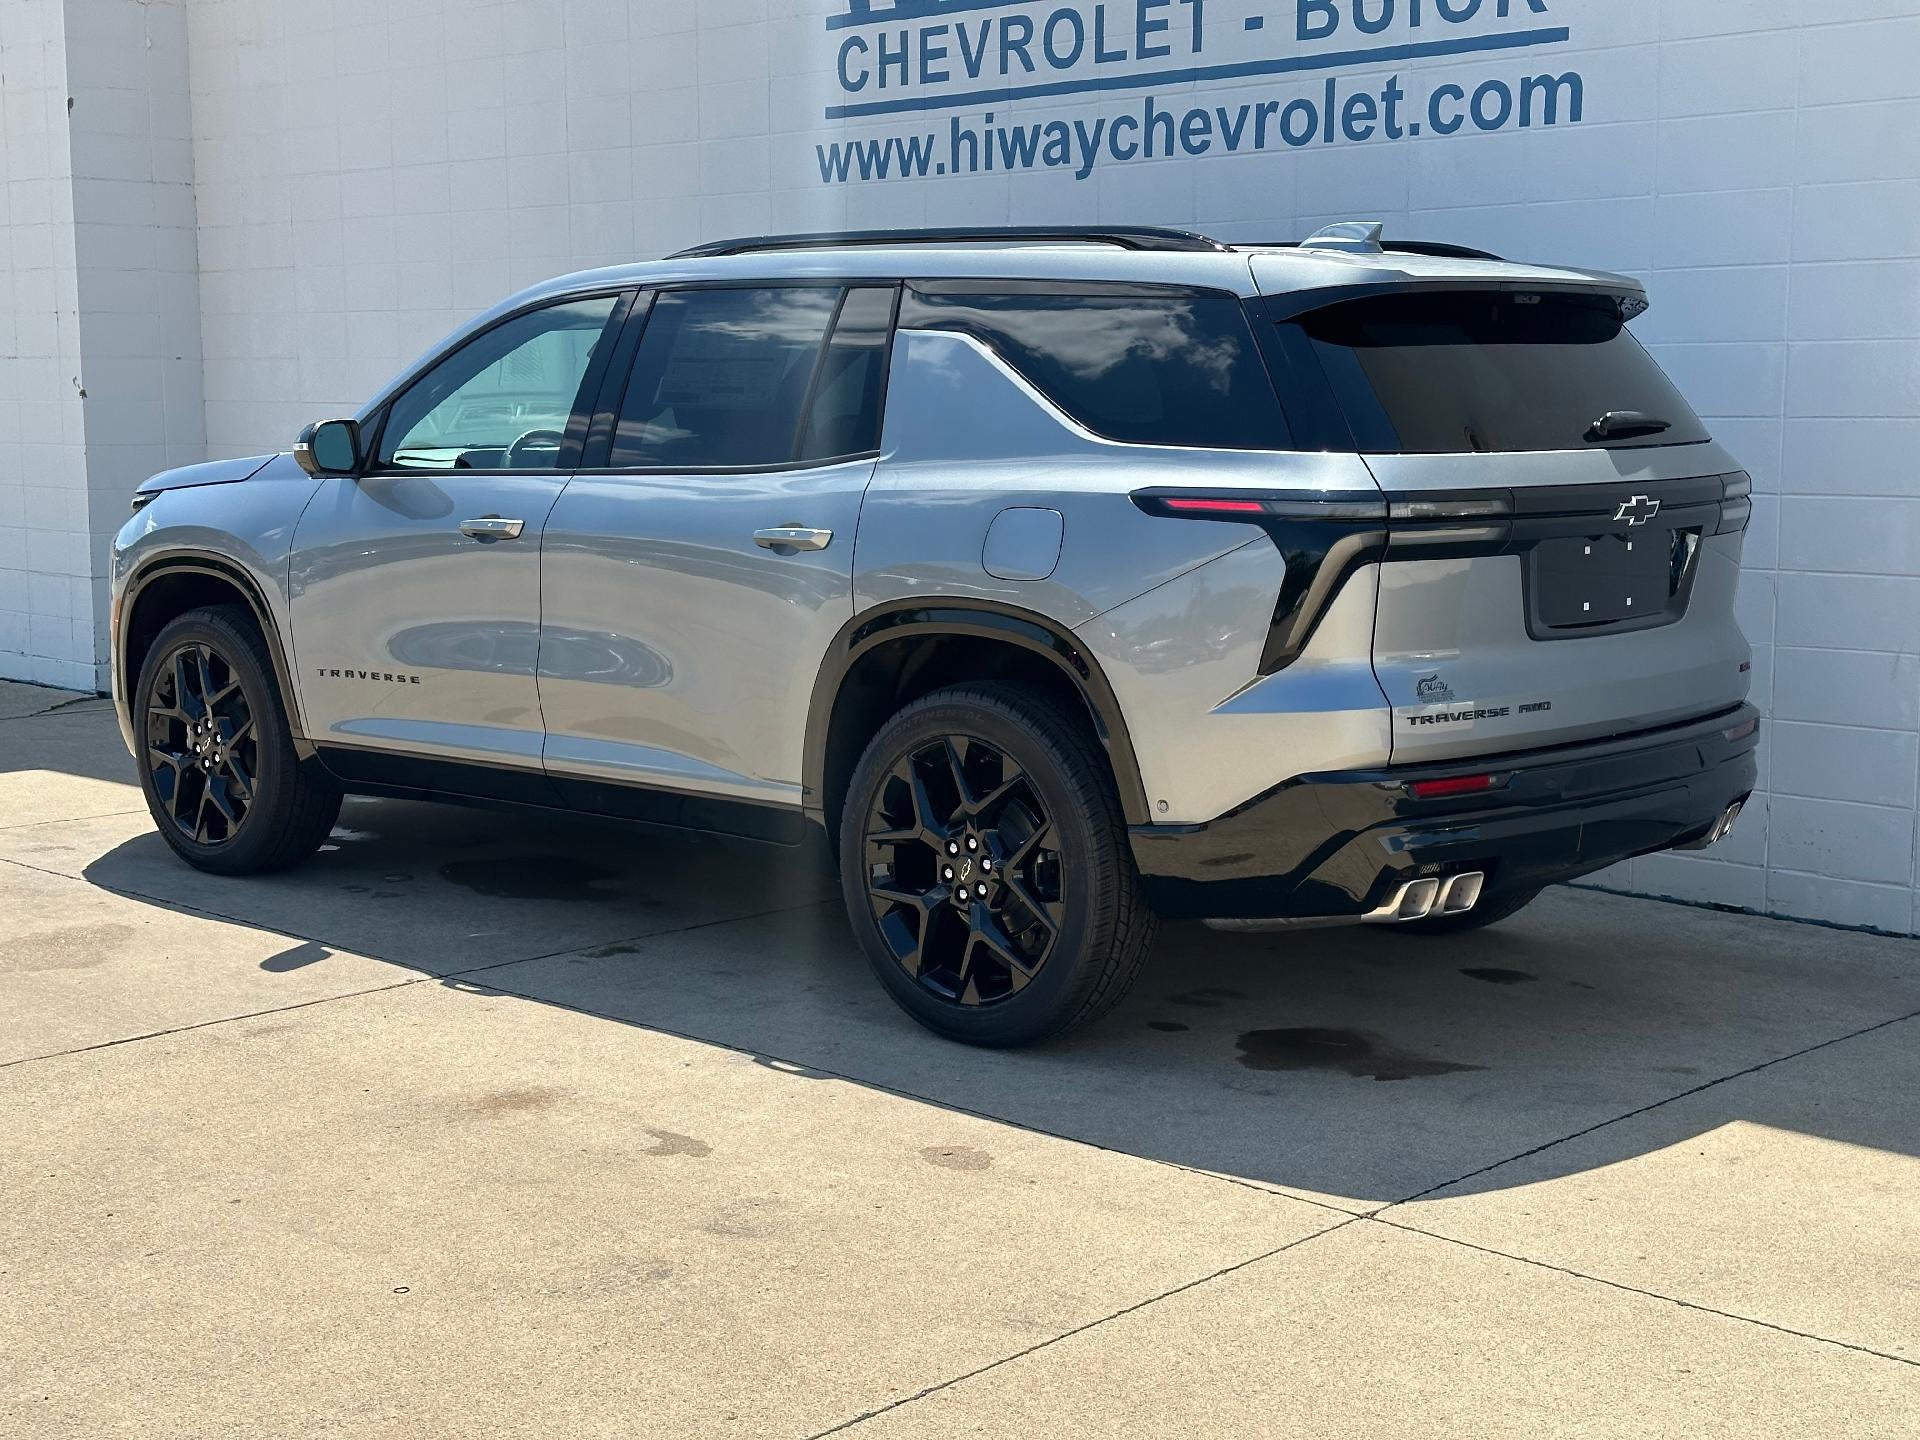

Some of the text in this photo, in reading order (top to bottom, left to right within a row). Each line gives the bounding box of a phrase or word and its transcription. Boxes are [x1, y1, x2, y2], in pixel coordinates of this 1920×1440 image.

[838, 0, 1203, 92] CHEVROLET
[816, 71, 1583, 183] www.hiwaychevrolet.com
[317, 668, 420, 684] TRAVERSE
[1407, 707, 1510, 726] TRAVERSE
